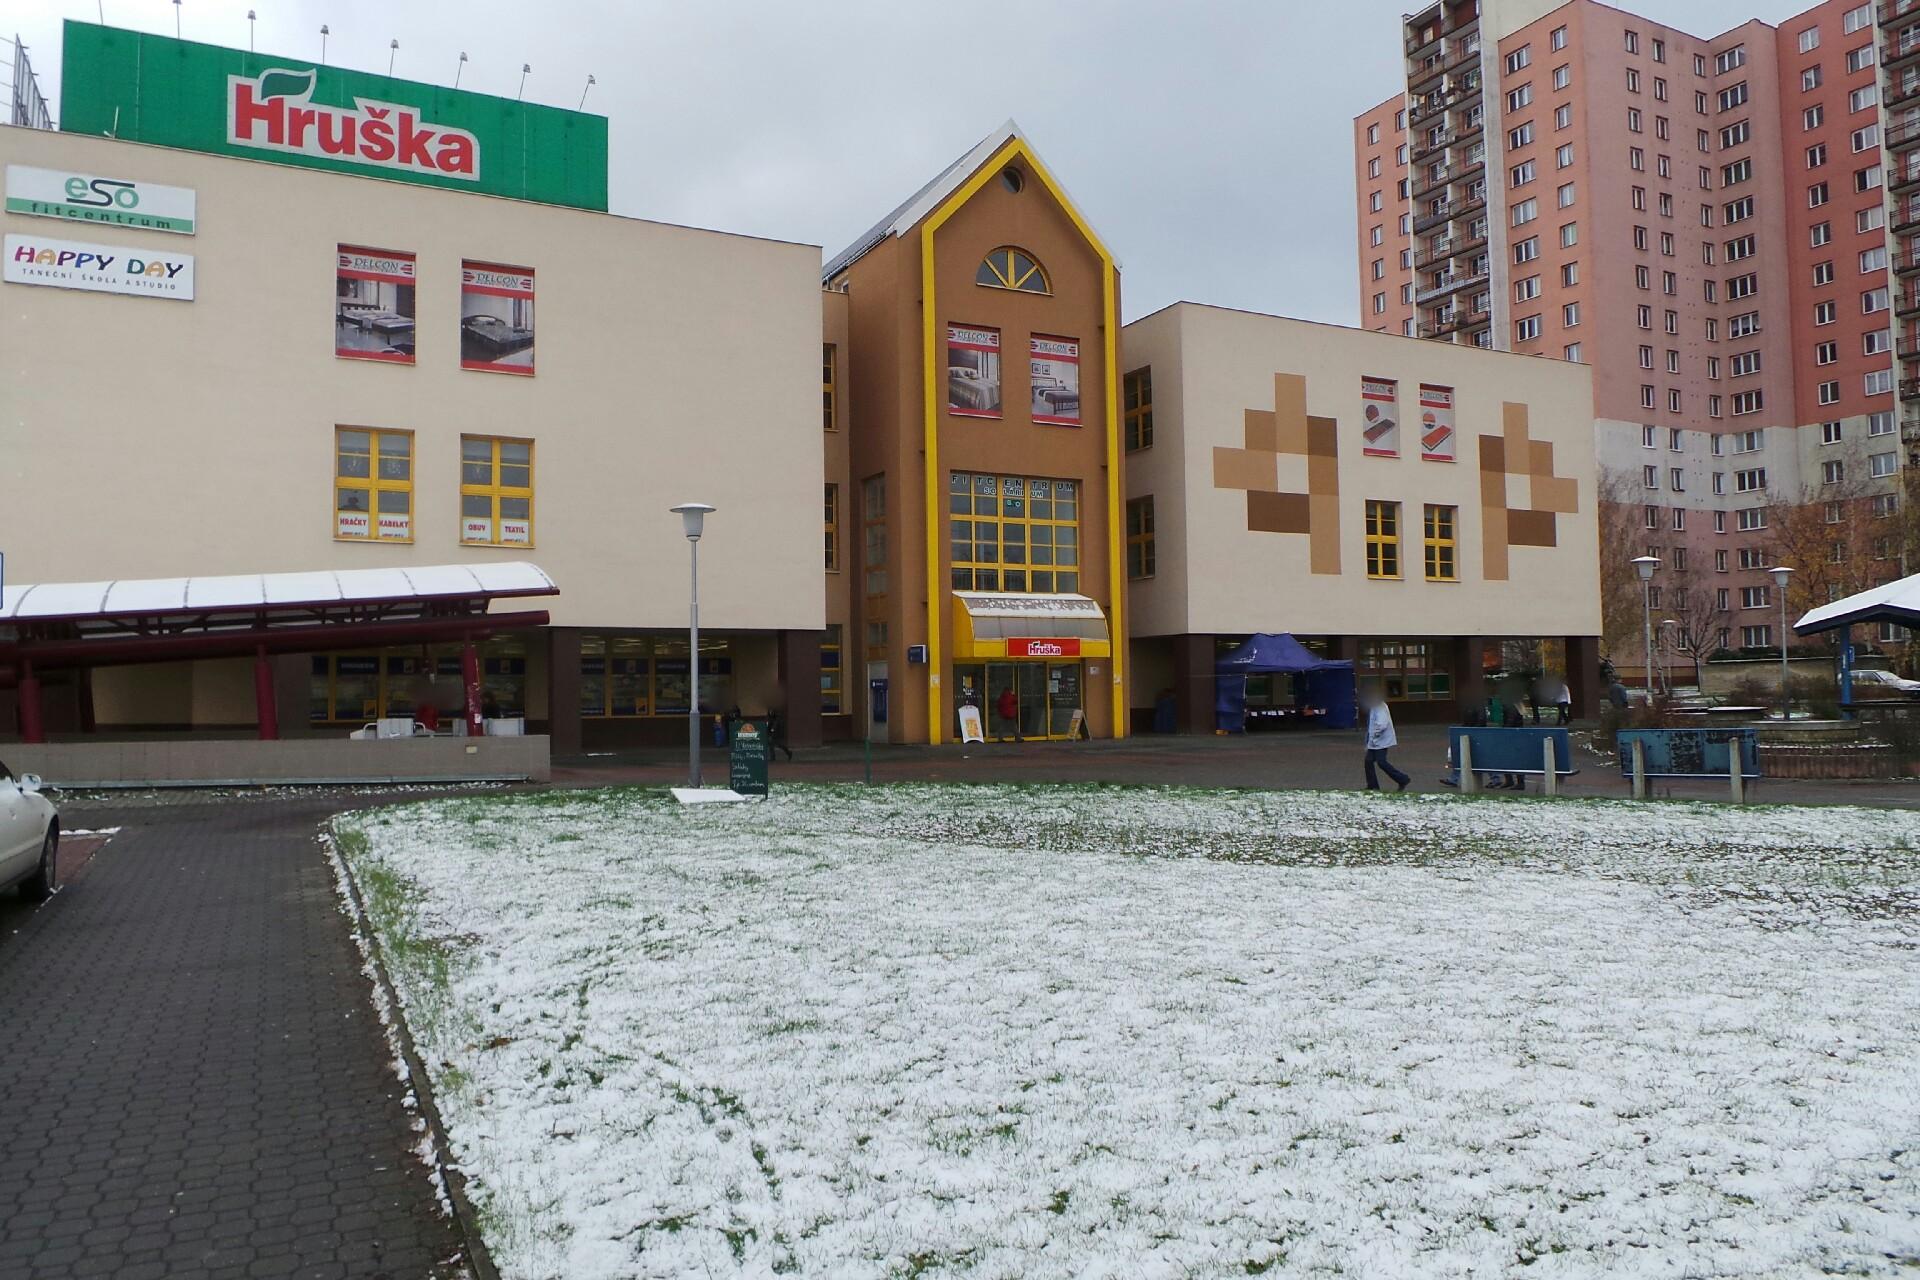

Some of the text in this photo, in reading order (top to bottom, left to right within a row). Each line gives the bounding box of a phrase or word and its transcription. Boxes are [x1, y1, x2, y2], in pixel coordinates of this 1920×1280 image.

[235, 83, 473, 174] Hruška
[32, 203, 170, 229] fitcentrum
[15, 246, 183, 279] HAPPY DAY
[354, 257, 399, 271] DELCON
[22, 268, 73, 280] TANEČNÍ
[82, 273, 117, 284] ŠKOLA
[136, 281, 176, 290] STUDIO
[477, 272, 518, 285] DELCON
[958, 330, 989, 342] DELCON
[1039, 342, 1067, 352] DELCON
[340, 517, 367, 526] HRAČKY
[1029, 644, 1061, 655] Hruška
